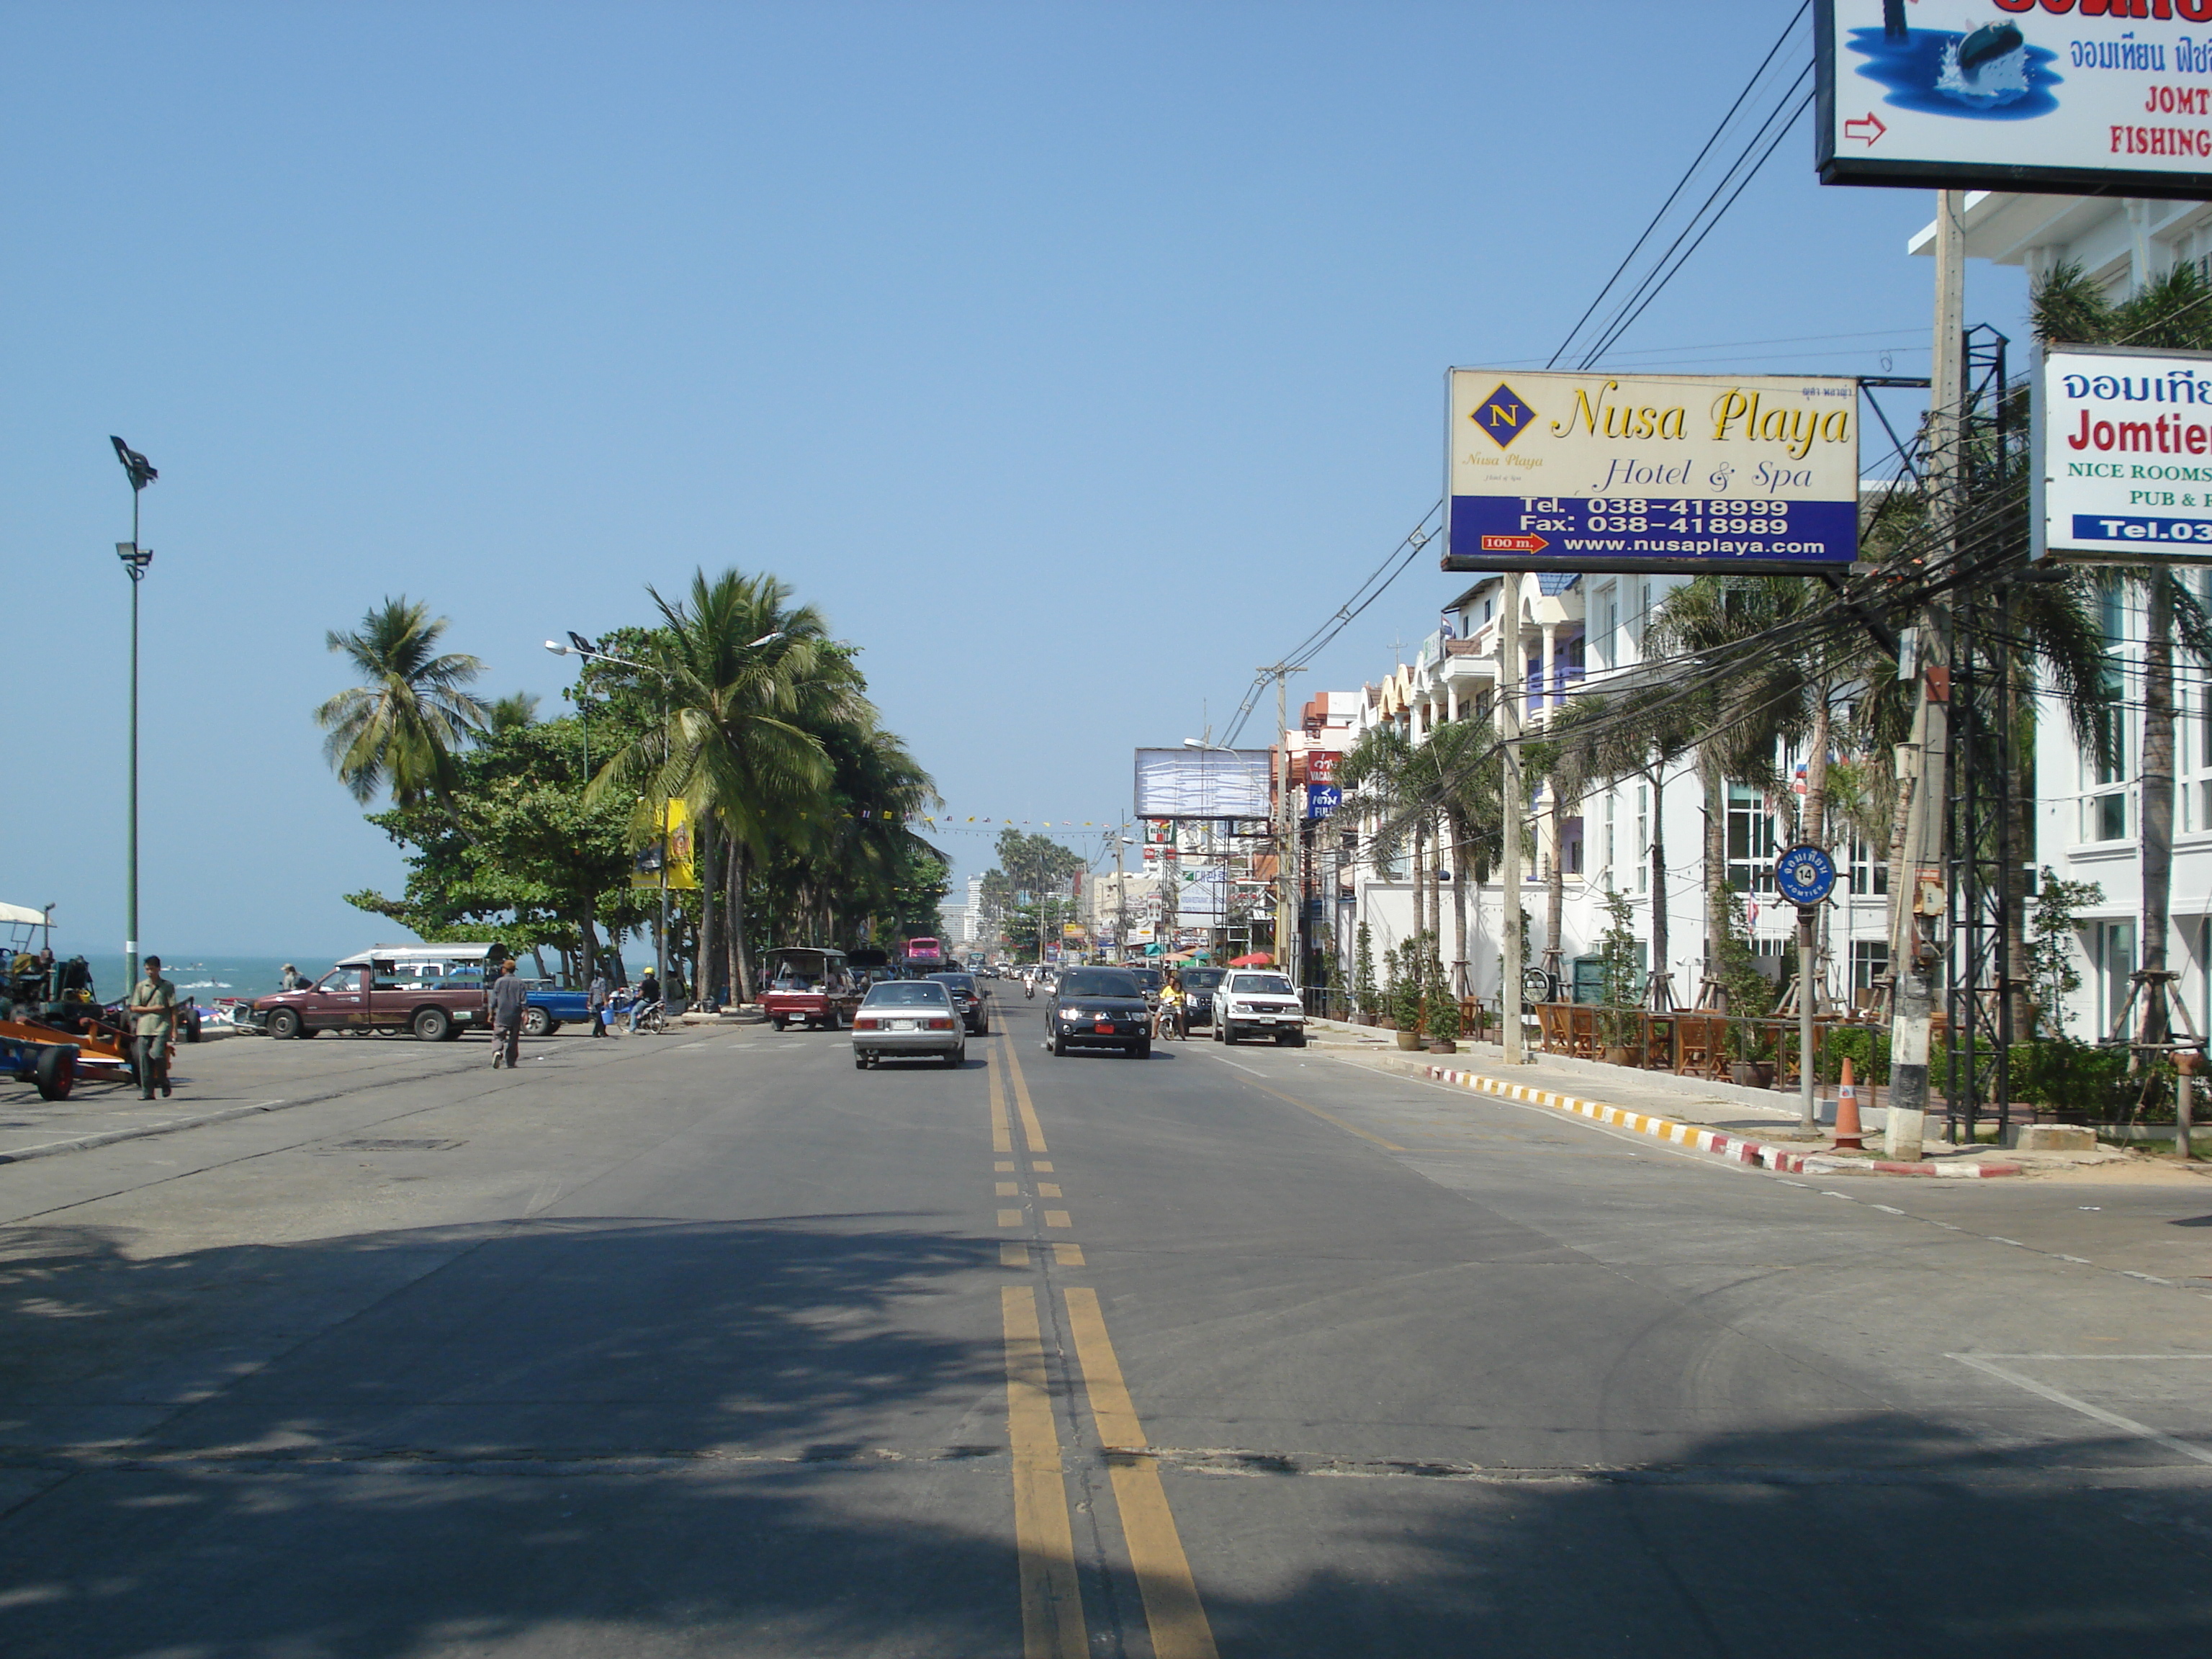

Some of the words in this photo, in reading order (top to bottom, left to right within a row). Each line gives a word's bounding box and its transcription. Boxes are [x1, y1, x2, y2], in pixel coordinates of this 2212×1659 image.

[2070, 32, 2166, 72] จอมเทียน
[2175, 36, 2212, 73] ฟิช
[2145, 85, 2212, 115] JOMT
[2110, 125, 2212, 157] FISHING
[1489, 404, 1519, 427] N
[1550, 380, 1688, 439] Nusa
[1709, 387, 1851, 460] Playa
[2067, 409, 2212, 454] Jomtie
[1462, 451, 1499, 465] Nusa
[1506, 453, 1544, 470] Playa
[1591, 459, 1692, 493] Hotel
[1709, 461, 1735, 493] &
[1751, 460, 1813, 494] Spa
[2067, 462, 2124, 479] NICE
[2131, 464, 2212, 482] ROOMS
[1519, 497, 1565, 513] Tel.
[1588, 498, 1789, 516] 038-418999
[2130, 490, 2175, 505] PUB
[2182, 493, 2196, 506] &
[1520, 515, 1575, 531] Fax:
[1588, 516, 1789, 535] 038-418989
[2099, 519, 2212, 541] Tel.03
[1486, 539, 1512, 548] 100
[1516, 539, 1534, 548] m.
[1563, 538, 1825, 555] www.nusaplaya.com
[1799, 869, 1812, 881] 14
[1786, 884, 1824, 897] JOMTIEN
